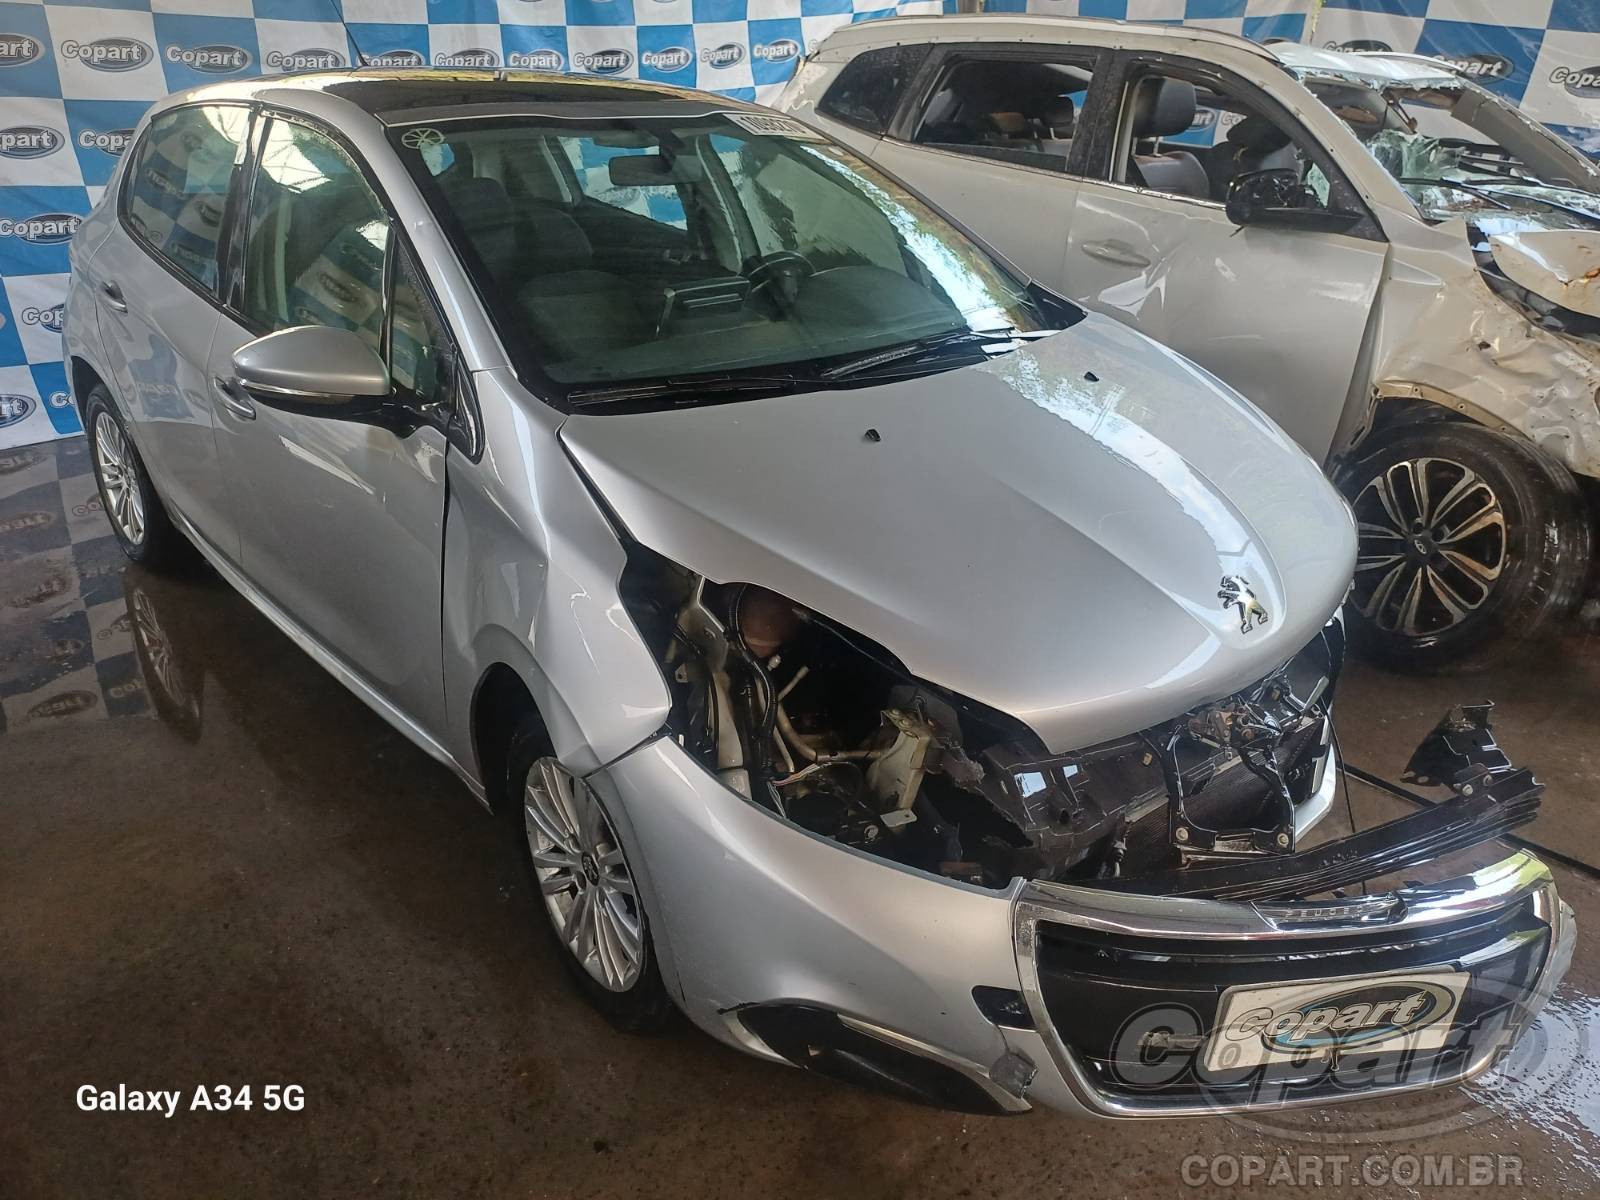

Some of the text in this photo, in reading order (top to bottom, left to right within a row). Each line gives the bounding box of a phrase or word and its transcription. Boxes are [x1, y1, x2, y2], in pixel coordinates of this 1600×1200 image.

[0, 38, 33, 58] art
[62, 39, 141, 63] Copart
[166, 46, 243, 67] Copart
[701, 47, 740, 62] Copart
[753, 43, 796, 59] Copart
[267, 50, 336, 69] Copart
[434, 52, 491, 67] Copart
[509, 52, 559, 68] Copart
[574, 52, 627, 68] Copart
[642, 51, 686, 66] Copart
[1551, 67, 1600, 88] Copa
[0, 131, 52, 151] part
[79, 131, 132, 152] Copa
[0, 217, 80, 240] Copart
[22, 307, 64, 328] Cop
[1224, 988, 1428, 1042] Copart
